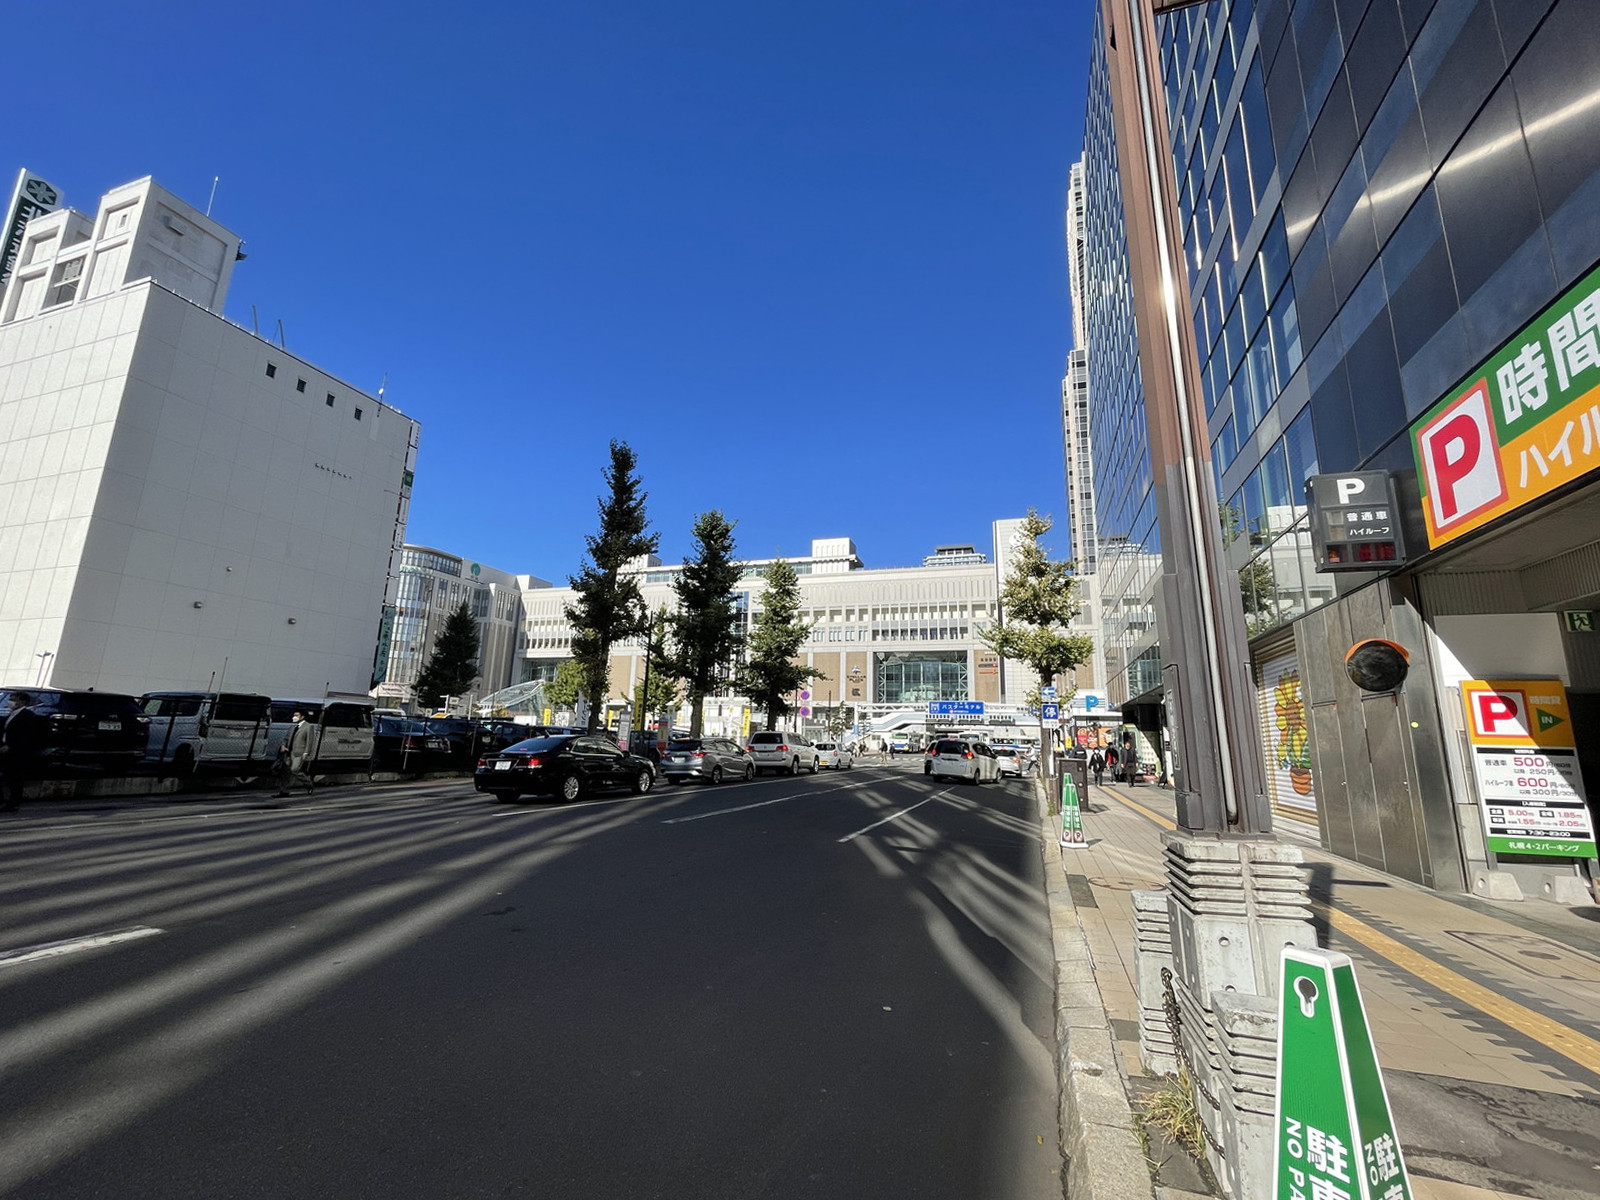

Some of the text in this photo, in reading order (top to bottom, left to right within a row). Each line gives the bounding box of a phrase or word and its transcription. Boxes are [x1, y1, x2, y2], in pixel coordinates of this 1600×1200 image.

[1496, 288, 1600, 425] 時間
[1429, 414, 1481, 520] P
[1336, 478, 1365, 504] P
[1346, 511, 1388, 522] 普通車
[1349, 527, 1390, 536] ハイルーフ
[1085, 695, 1098, 712] P
[1478, 695, 1518, 733] P
[1541, 715, 1553, 724] IN
